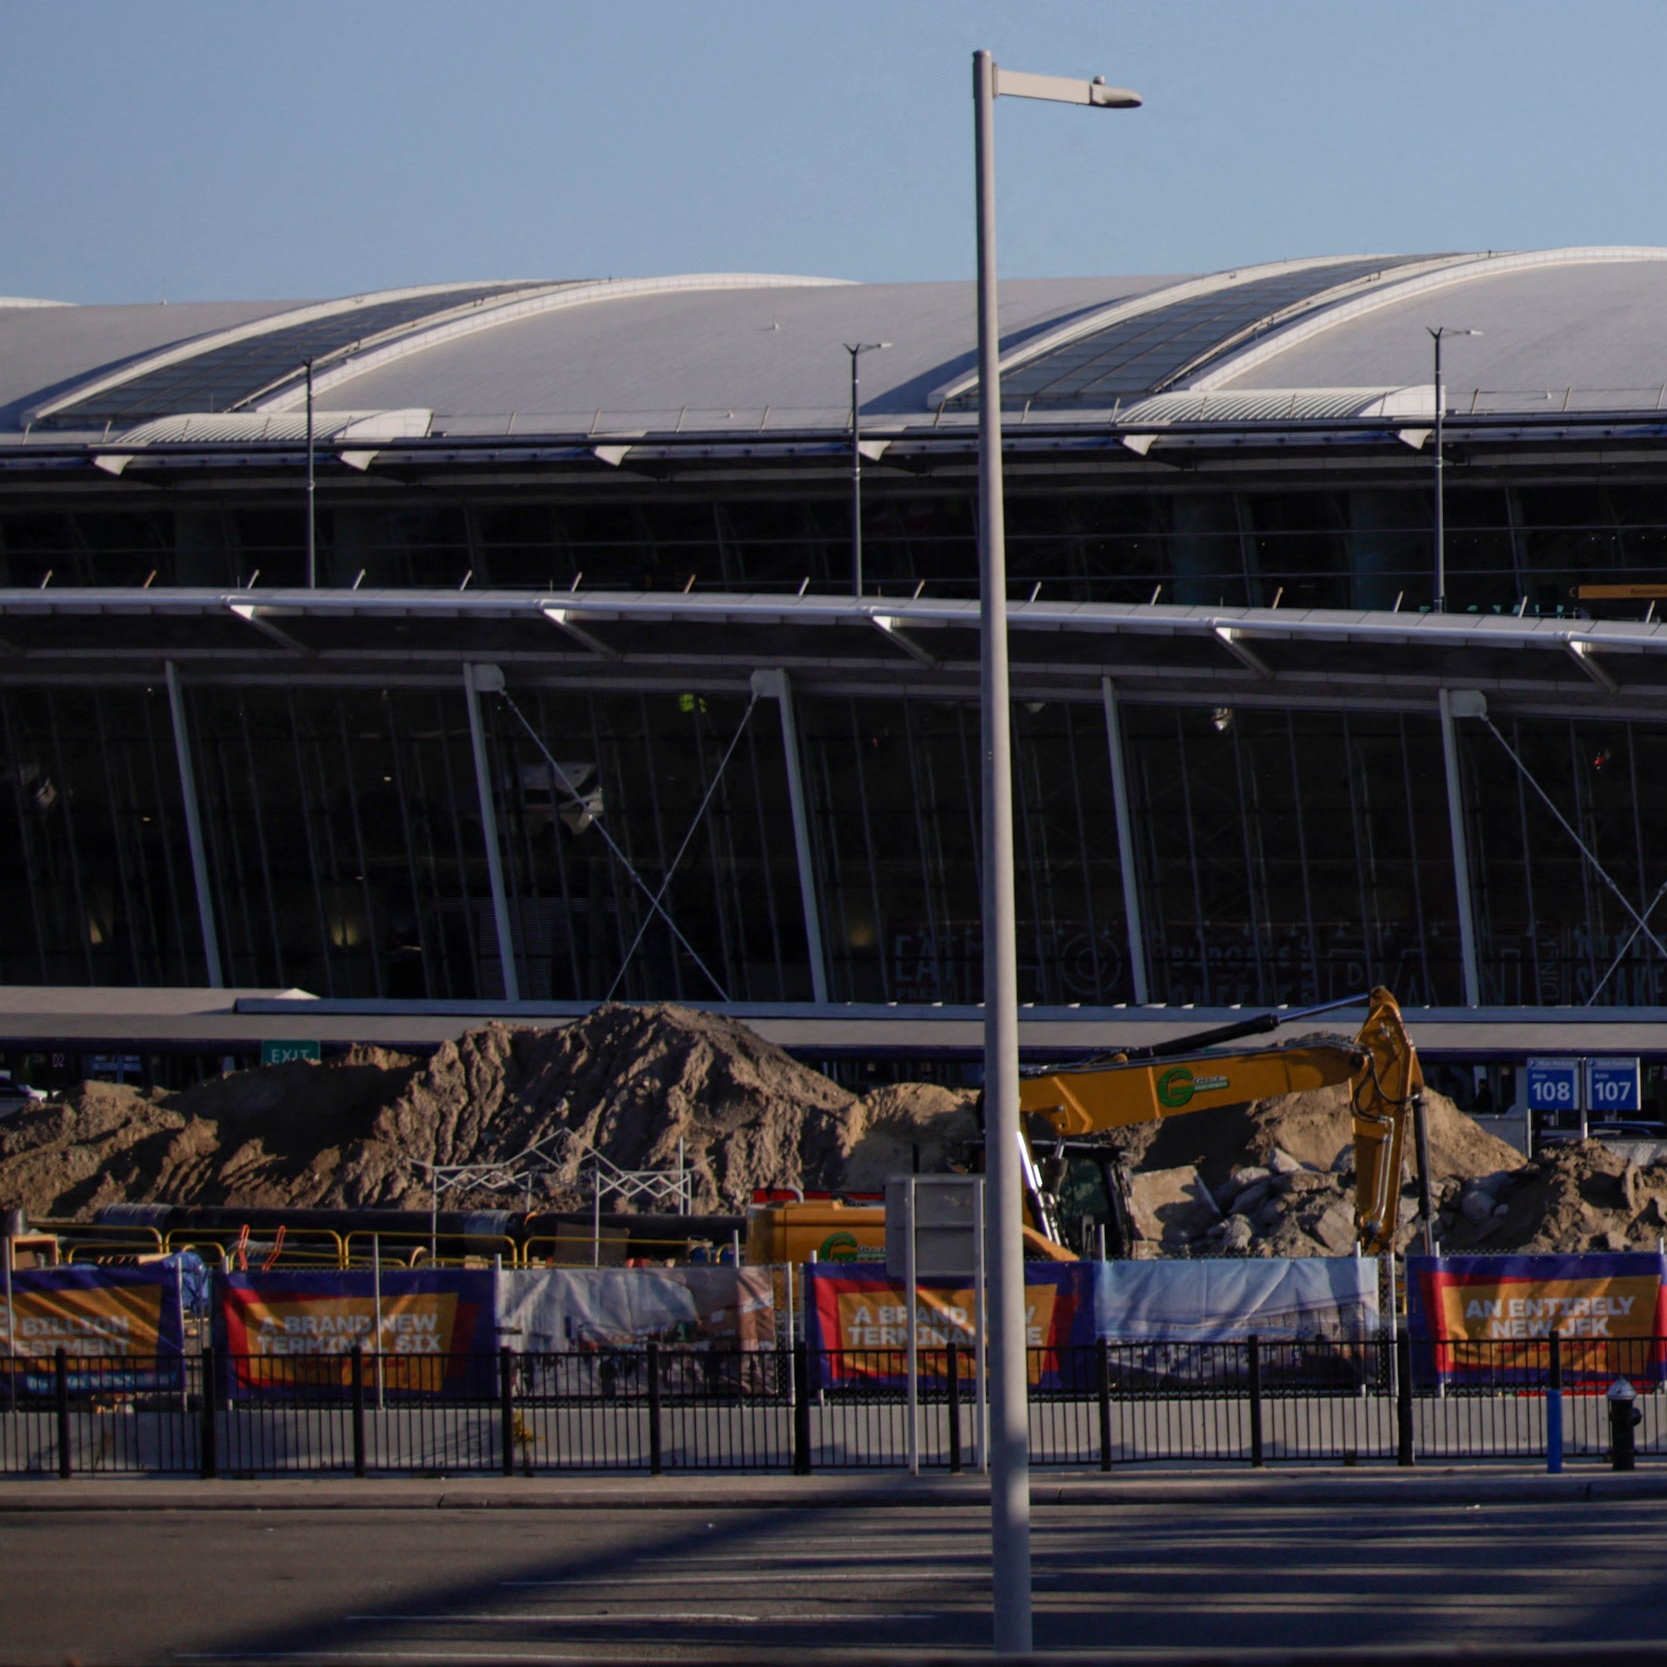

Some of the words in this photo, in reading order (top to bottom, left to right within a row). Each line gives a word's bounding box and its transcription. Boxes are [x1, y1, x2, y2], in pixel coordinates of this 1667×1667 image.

[270, 1048, 310, 1062] EXIT
[1532, 1081, 1571, 1101] 108
[1594, 1081, 1632, 1101] 107
[853, 1306, 872, 1325] A
[878, 1306, 968, 1325] BRAND
[1465, 1299, 1503, 1318] AN
[1508, 1296, 1635, 1317] ENTIRELY
[22, 1316, 130, 1336] BILLION
[260, 1316, 278, 1335] A
[284, 1315, 372, 1334] BRAND
[379, 1313, 439, 1333] NEW
[1491, 1319, 1553, 1338] NEW
[1559, 1317, 1611, 1337] JFK
[0, 1338, 131, 1356] ESTMENT
[395, 1334, 442, 1354] SIX
